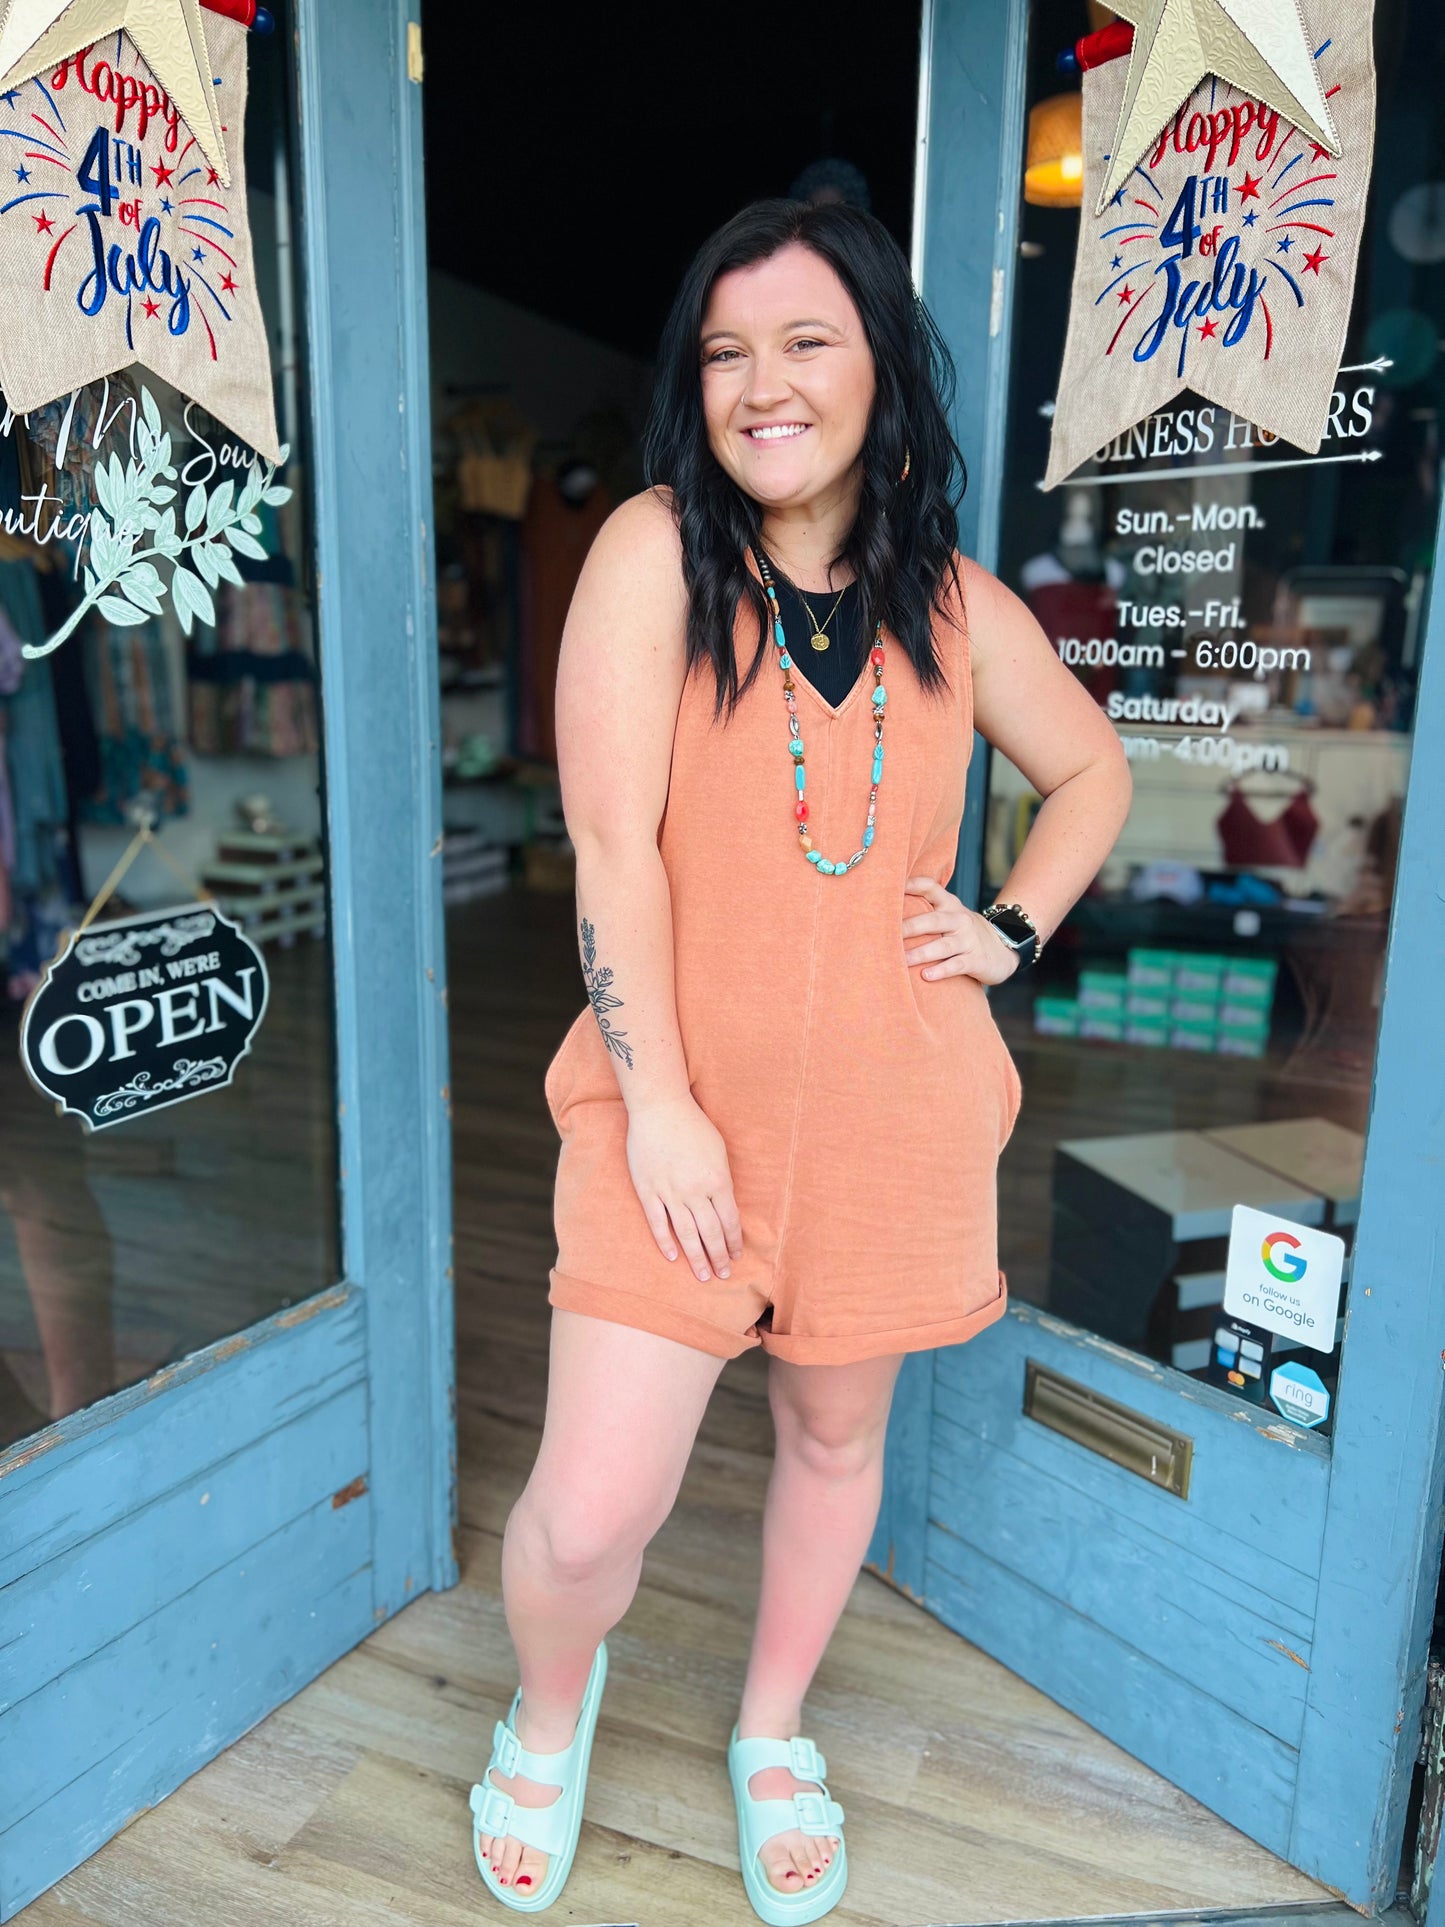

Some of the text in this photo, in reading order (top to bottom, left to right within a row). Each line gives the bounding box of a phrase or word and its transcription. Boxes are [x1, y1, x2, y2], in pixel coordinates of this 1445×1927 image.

[76, 125, 142, 217] 4TH
[1159, 175, 1229, 259] 4TH
[76, 204, 191, 336] July
[1133, 235, 1267, 363] July
[1133, 542, 1236, 576] Closed
[1058, 638, 1165, 668] 10:00am
[1195, 640, 1312, 680] 6:00pm
[1107, 691, 1238, 734] Saturday
[77, 951, 221, 1002] COME IN, WE'RE
[38, 966, 257, 1076] OPEN
[1242, 1292, 1315, 1328] on Google
[1259, 1283, 1301, 1307] follow us
[1284, 1383, 1313, 1408] ring
